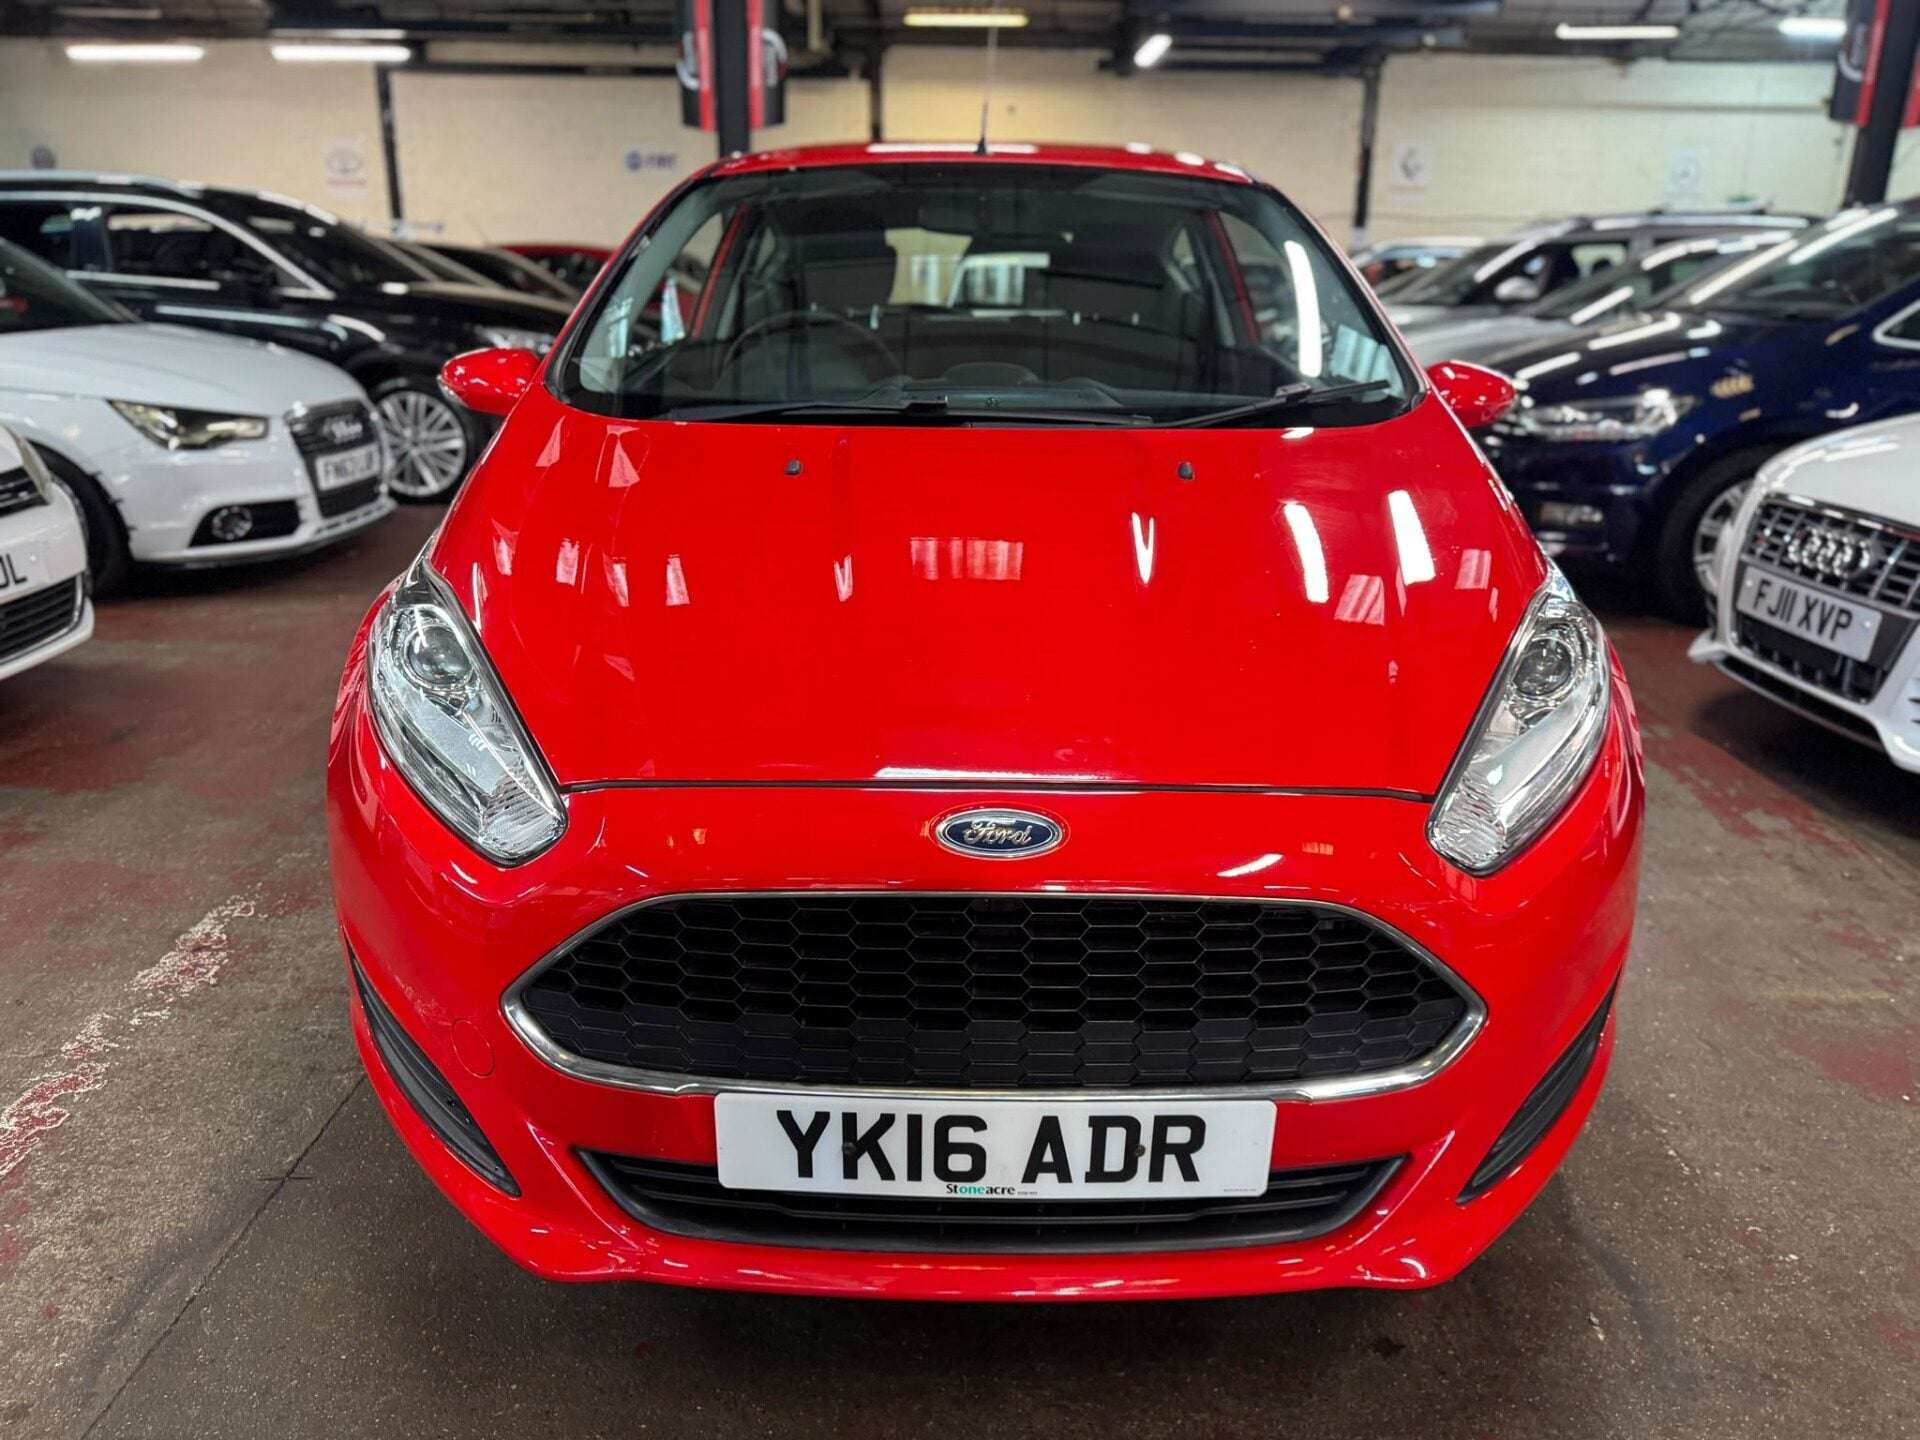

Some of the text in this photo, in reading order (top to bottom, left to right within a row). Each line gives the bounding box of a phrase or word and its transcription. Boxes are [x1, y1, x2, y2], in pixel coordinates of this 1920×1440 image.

[1752, 579, 1853, 640] FJ11 XVP
[963, 817, 1033, 845] Ford
[776, 1110, 1206, 1184] YK16 ADR
[946, 1183, 1015, 1195] Stoneacre
